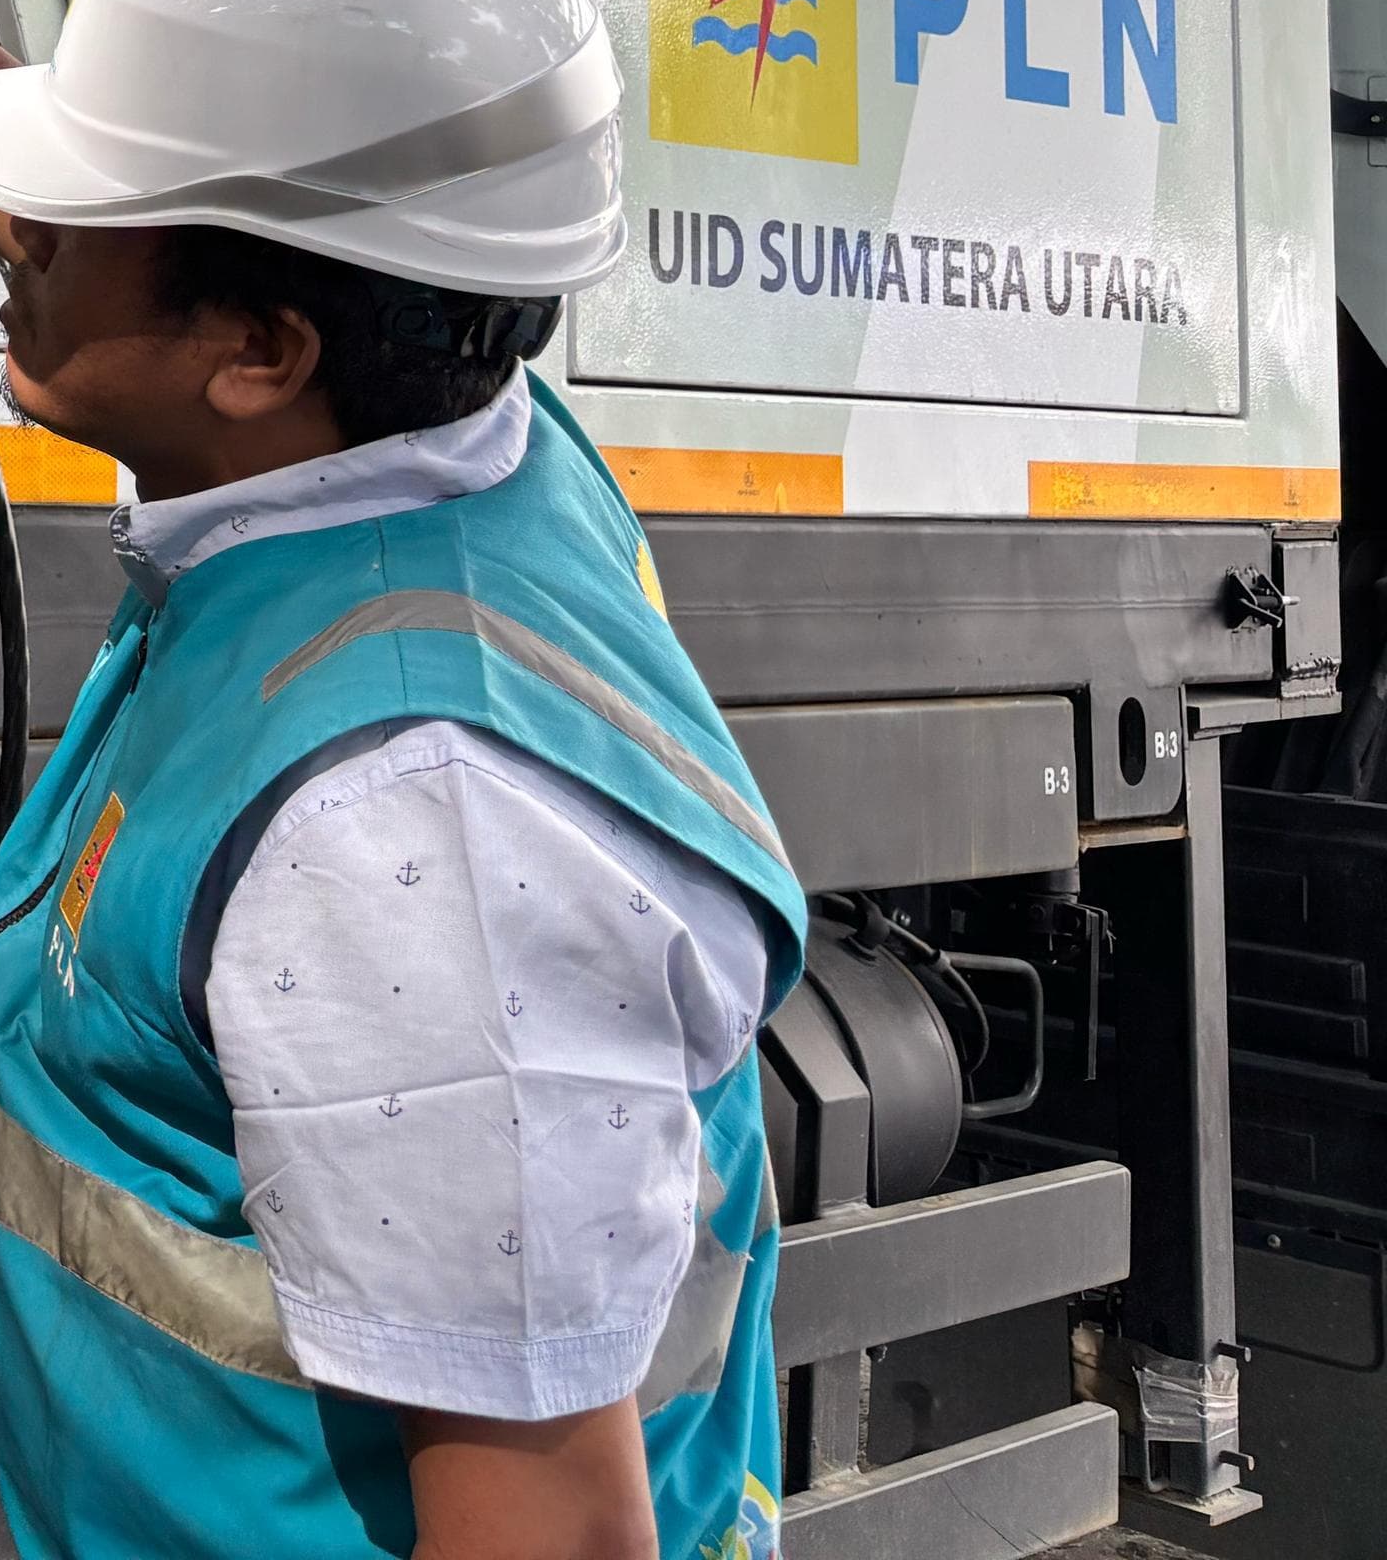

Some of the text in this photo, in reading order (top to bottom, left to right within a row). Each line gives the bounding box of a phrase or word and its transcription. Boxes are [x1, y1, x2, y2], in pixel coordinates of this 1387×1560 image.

[648, 207, 1187, 325] UID SUMATERA UTARA
